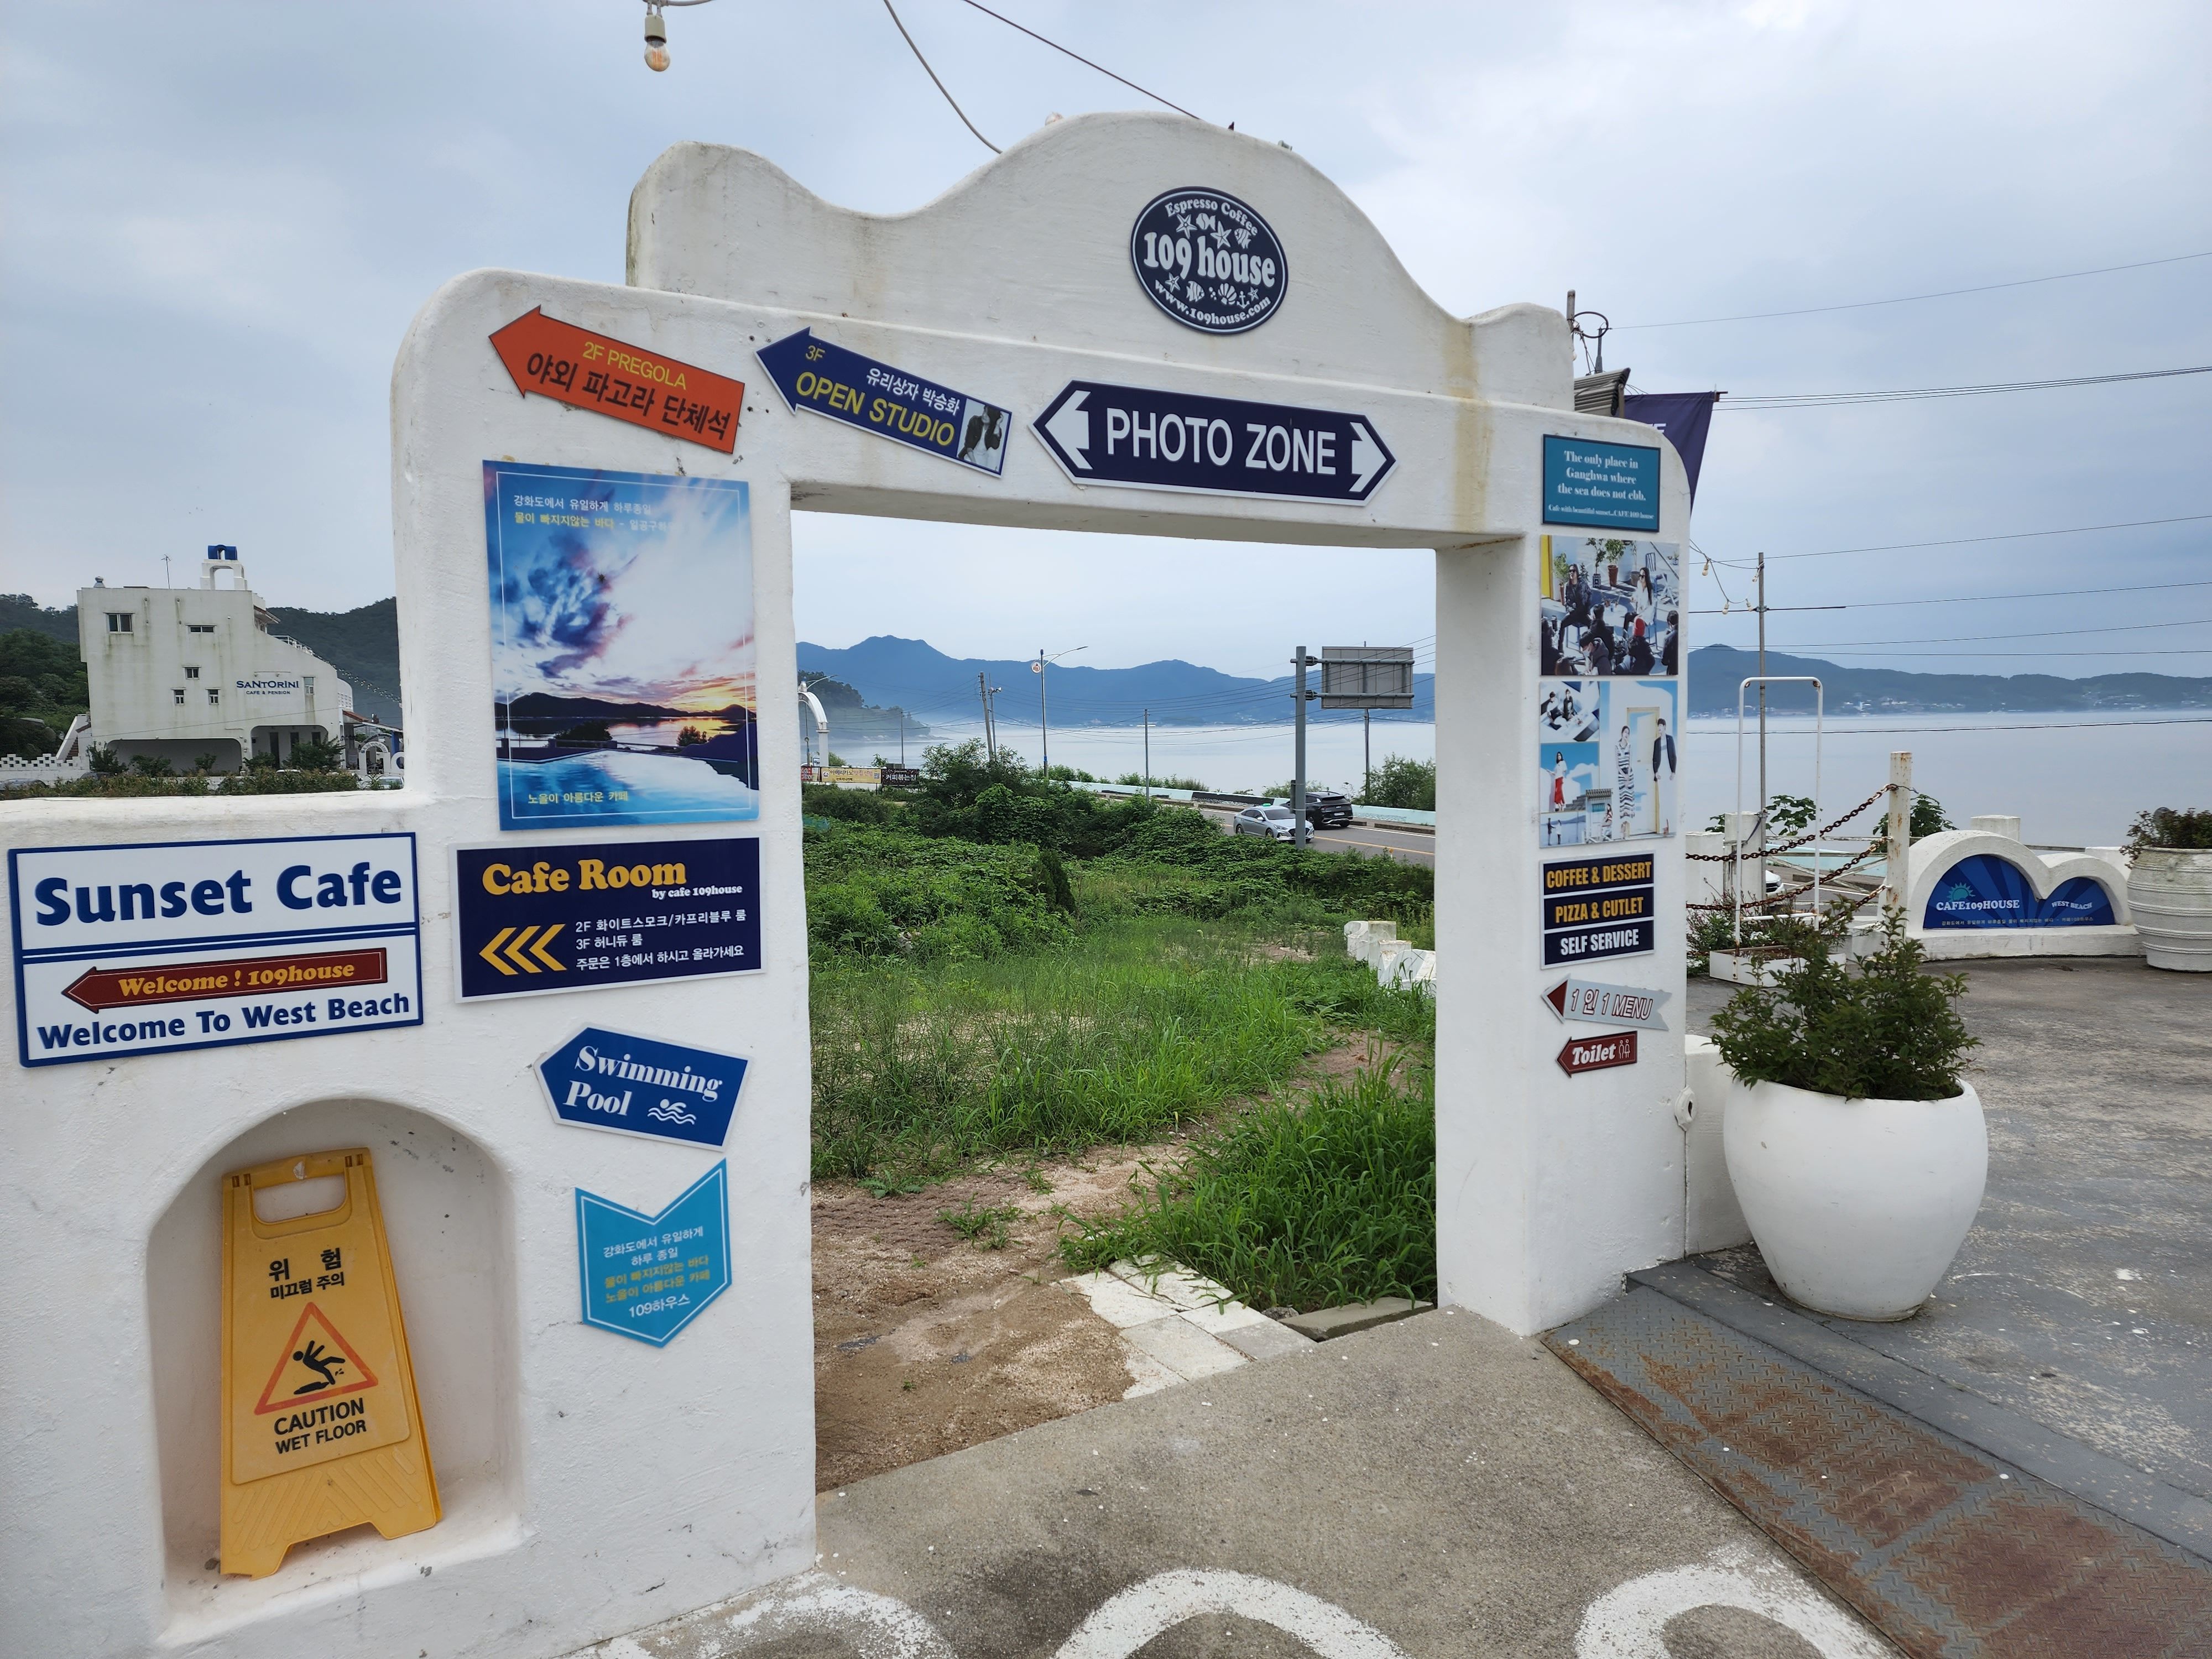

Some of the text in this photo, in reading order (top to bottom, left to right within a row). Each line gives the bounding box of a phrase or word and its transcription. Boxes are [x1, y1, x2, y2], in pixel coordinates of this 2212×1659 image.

[1165, 199, 1258, 236] Espresso Coffee
[1144, 232, 1275, 287] 109 house
[1155, 279, 1271, 324] www.109house.com
[582, 341, 687, 390] 2F PREGOLA
[805, 345, 825, 362] 3F
[527, 352, 731, 441] 야외 파고라 단체석
[867, 368, 961, 416] 유리상자 박승화
[796, 372, 954, 446] OPEN STUDIO
[1107, 408, 1336, 474] PHOTO ZONE
[1564, 450, 1638, 468] The only place in
[1566, 467, 1636, 484] Ganghwa where
[514, 494, 651, 515] 강화도에서 유일하게 하루종일
[1558, 483, 1572, 494] the
[1591, 486, 1610, 497] does
[1613, 491, 1626, 499] not
[514, 512, 534, 524] 물이
[540, 514, 589, 528] 빠지지않는
[595, 518, 613, 529] 바다
[528, 791, 628, 804] 노을이 아름다운 카페
[482, 858, 686, 895] Cafe Room
[1547, 862, 1652, 888] COFFEE & DESSERT
[34, 862, 401, 926] Sunset Cafe
[651, 885, 742, 900] by cafe 109house
[1936, 900, 2020, 911] CAFE109HOUSE
[575, 909, 747, 932] 2F 화이트스모크/카프리블루 룸
[1555, 897, 1644, 923] PIZZA & CUTLET
[576, 933, 643, 950] 3F 허니듀 룸
[1561, 929, 1639, 956] SELF SERVICE
[576, 945, 744, 970] 주문은 1층에서 하시고 올라가세요
[118, 973, 228, 997] Welcome
[247, 962, 355, 987] 109house
[1583, 989, 1599, 1015] 인
[1612, 994, 1653, 1020] MENU
[36, 993, 409, 1050] Welcome To West Beach
[1572, 1044, 1616, 1065] Toilet
[574, 1045, 722, 1102] Swimming
[562, 1080, 633, 1115] Pool
[603, 1225, 703, 1258] 강화도에서 유일하게
[631, 1247, 678, 1266] 하루 종일
[688, 1255, 708, 1267] 바다
[270, 1272, 345, 1300] 미끄럼 주의
[629, 1293, 690, 1318] 109하우스
[273, 1397, 364, 1434] CAUTION
[275, 1420, 367, 1454] WET FLOOR
